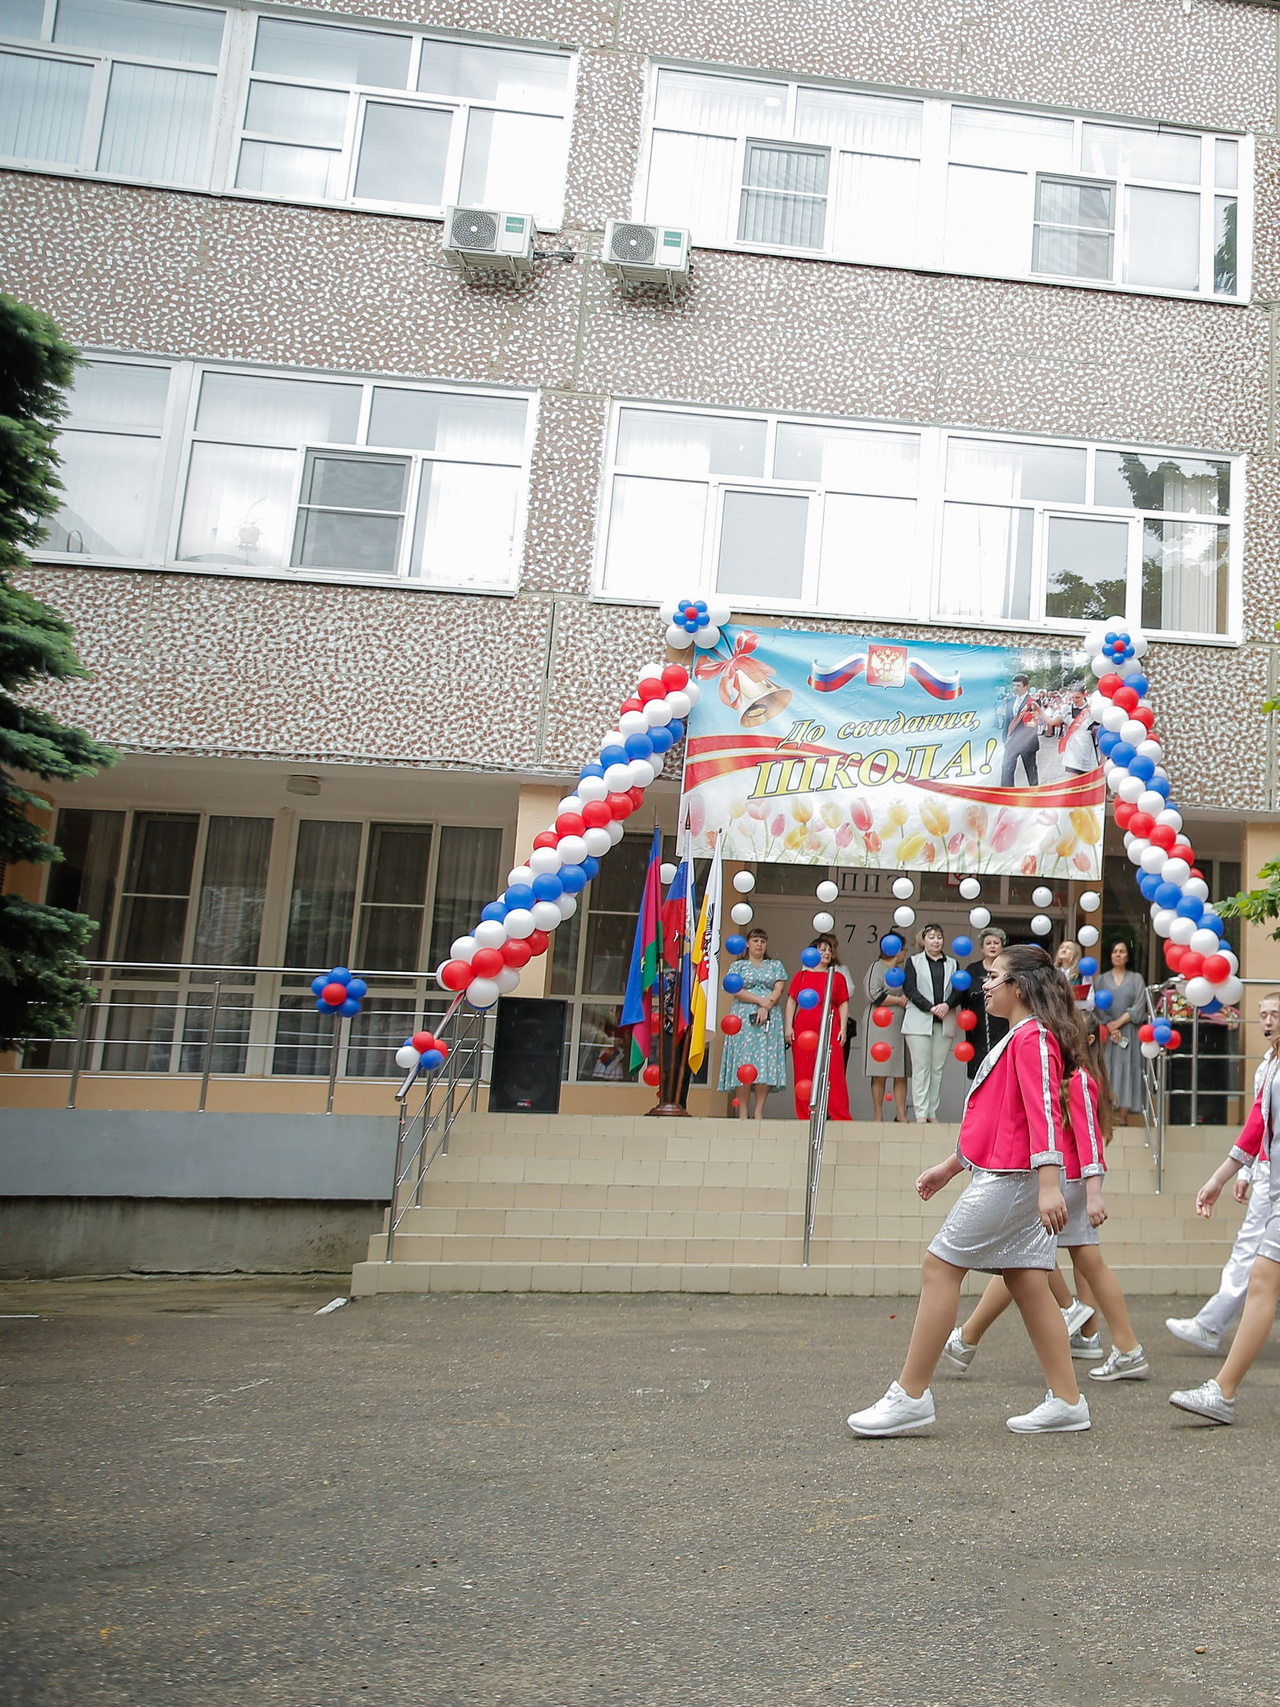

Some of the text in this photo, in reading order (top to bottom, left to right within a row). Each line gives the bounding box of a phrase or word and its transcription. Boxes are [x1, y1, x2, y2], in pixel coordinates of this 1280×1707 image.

[775, 710, 981, 751] До свидания,
[747, 738, 998, 800] ШКОЛА!
